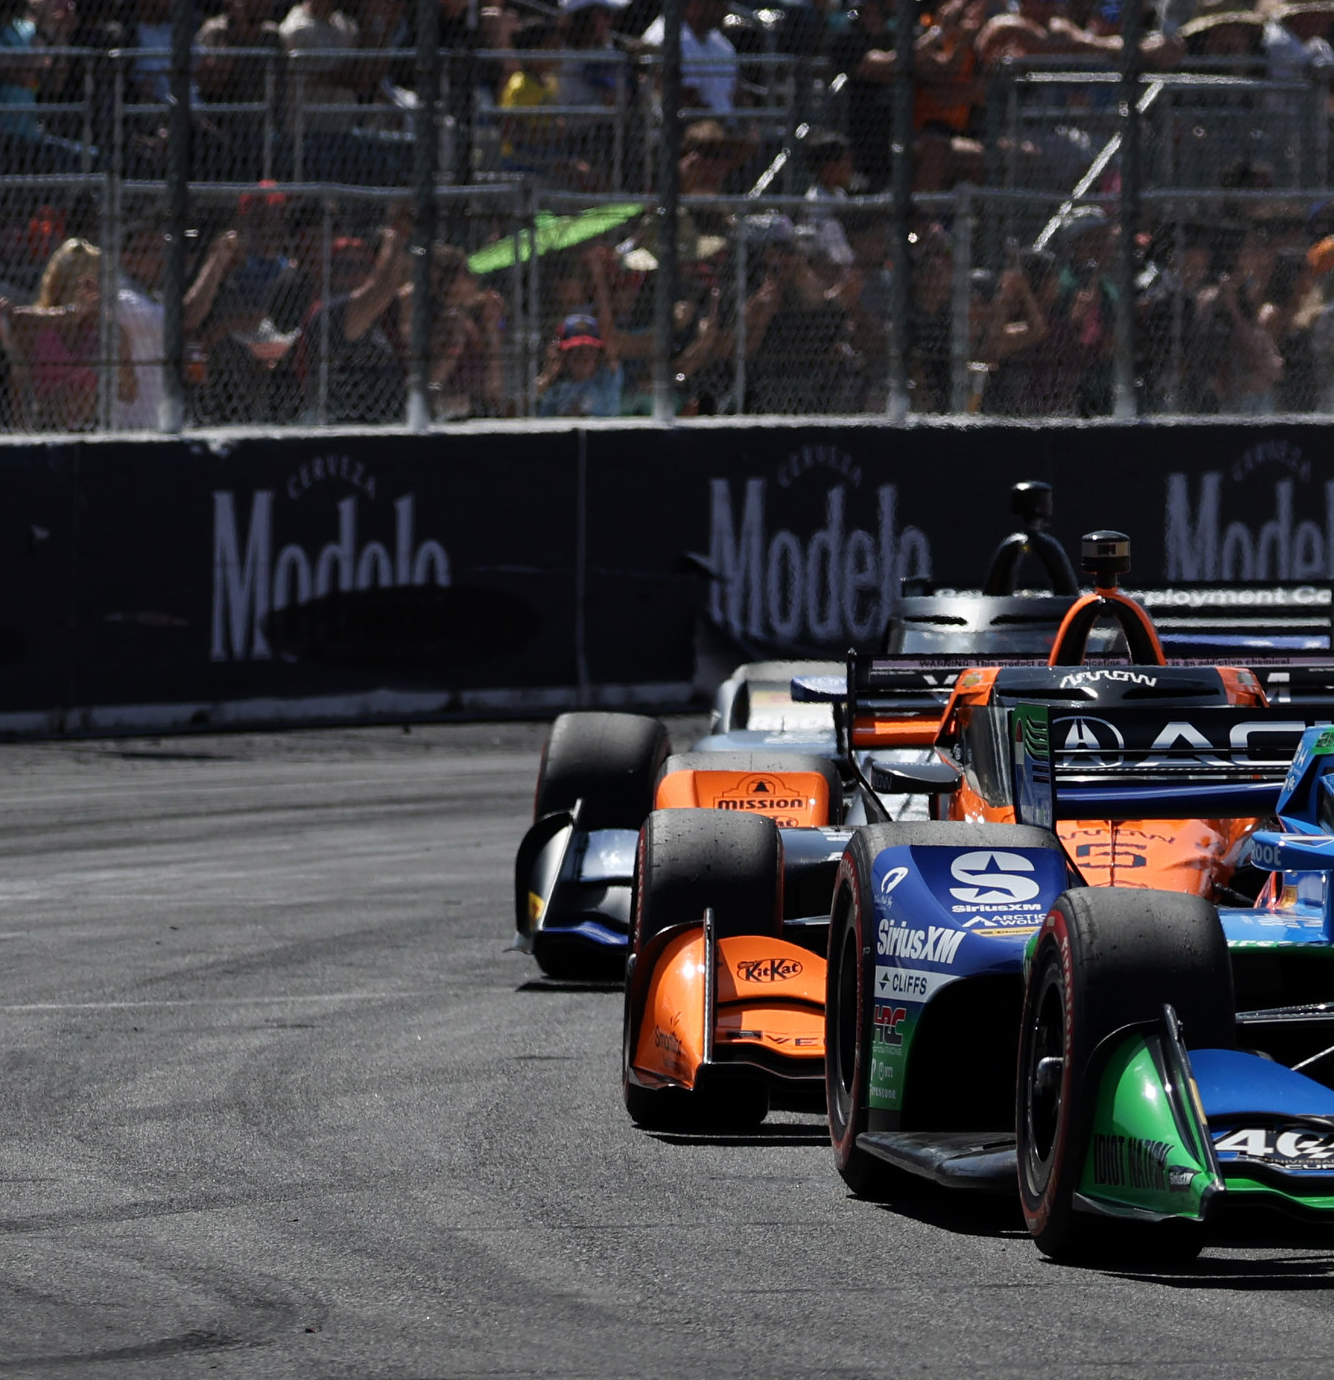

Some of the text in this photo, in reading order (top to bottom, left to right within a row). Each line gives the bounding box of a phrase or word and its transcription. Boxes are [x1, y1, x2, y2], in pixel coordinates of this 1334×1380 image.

[286, 454, 376, 499] CERVEZA
[777, 441, 863, 488] CERVEZA
[1231, 439, 1313, 482] CERVEZA
[707, 476, 933, 642] Modelo
[951, 903, 1041, 913] SiriusXM
[877, 919, 967, 965] SiriusXM
[746, 959, 799, 982] KitKat
[892, 973, 927, 995] CLIFFS
